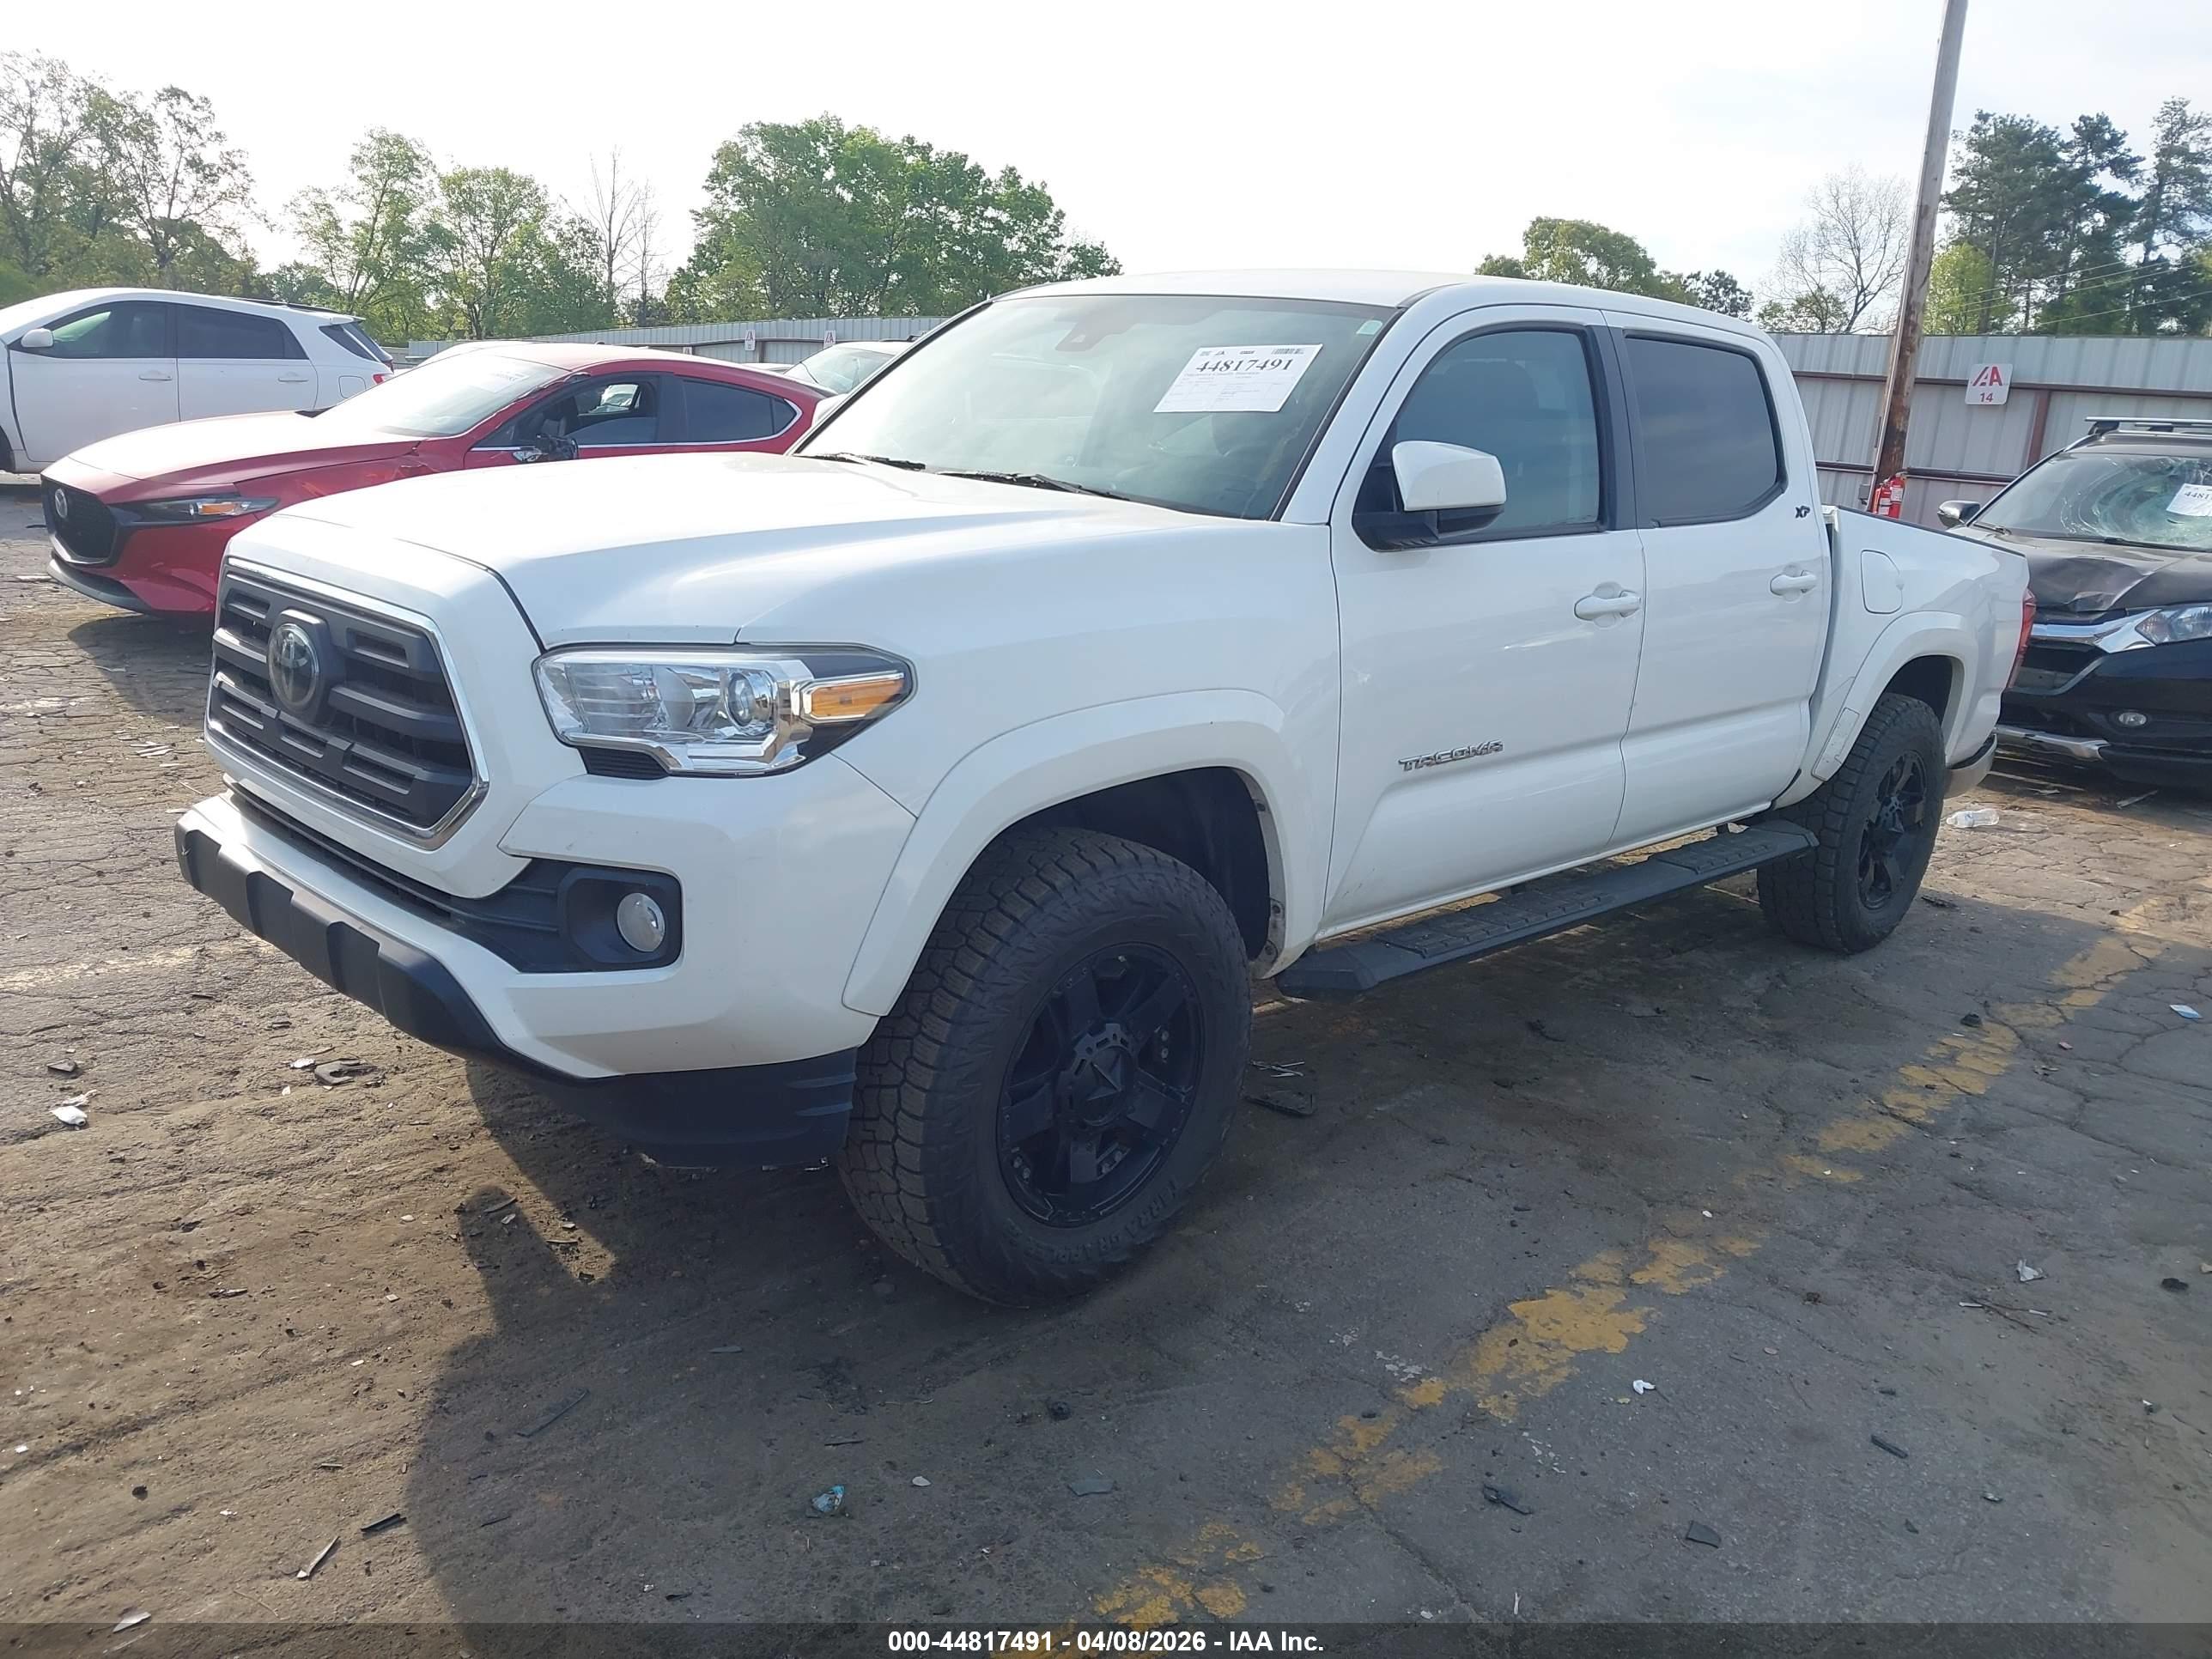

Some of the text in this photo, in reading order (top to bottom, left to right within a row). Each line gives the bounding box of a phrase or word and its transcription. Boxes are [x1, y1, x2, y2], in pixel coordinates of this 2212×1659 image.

[1195, 358, 1293, 373] 44817491
[1980, 392, 1994, 403] 14
[1398, 739, 1504, 772] TACOMA
